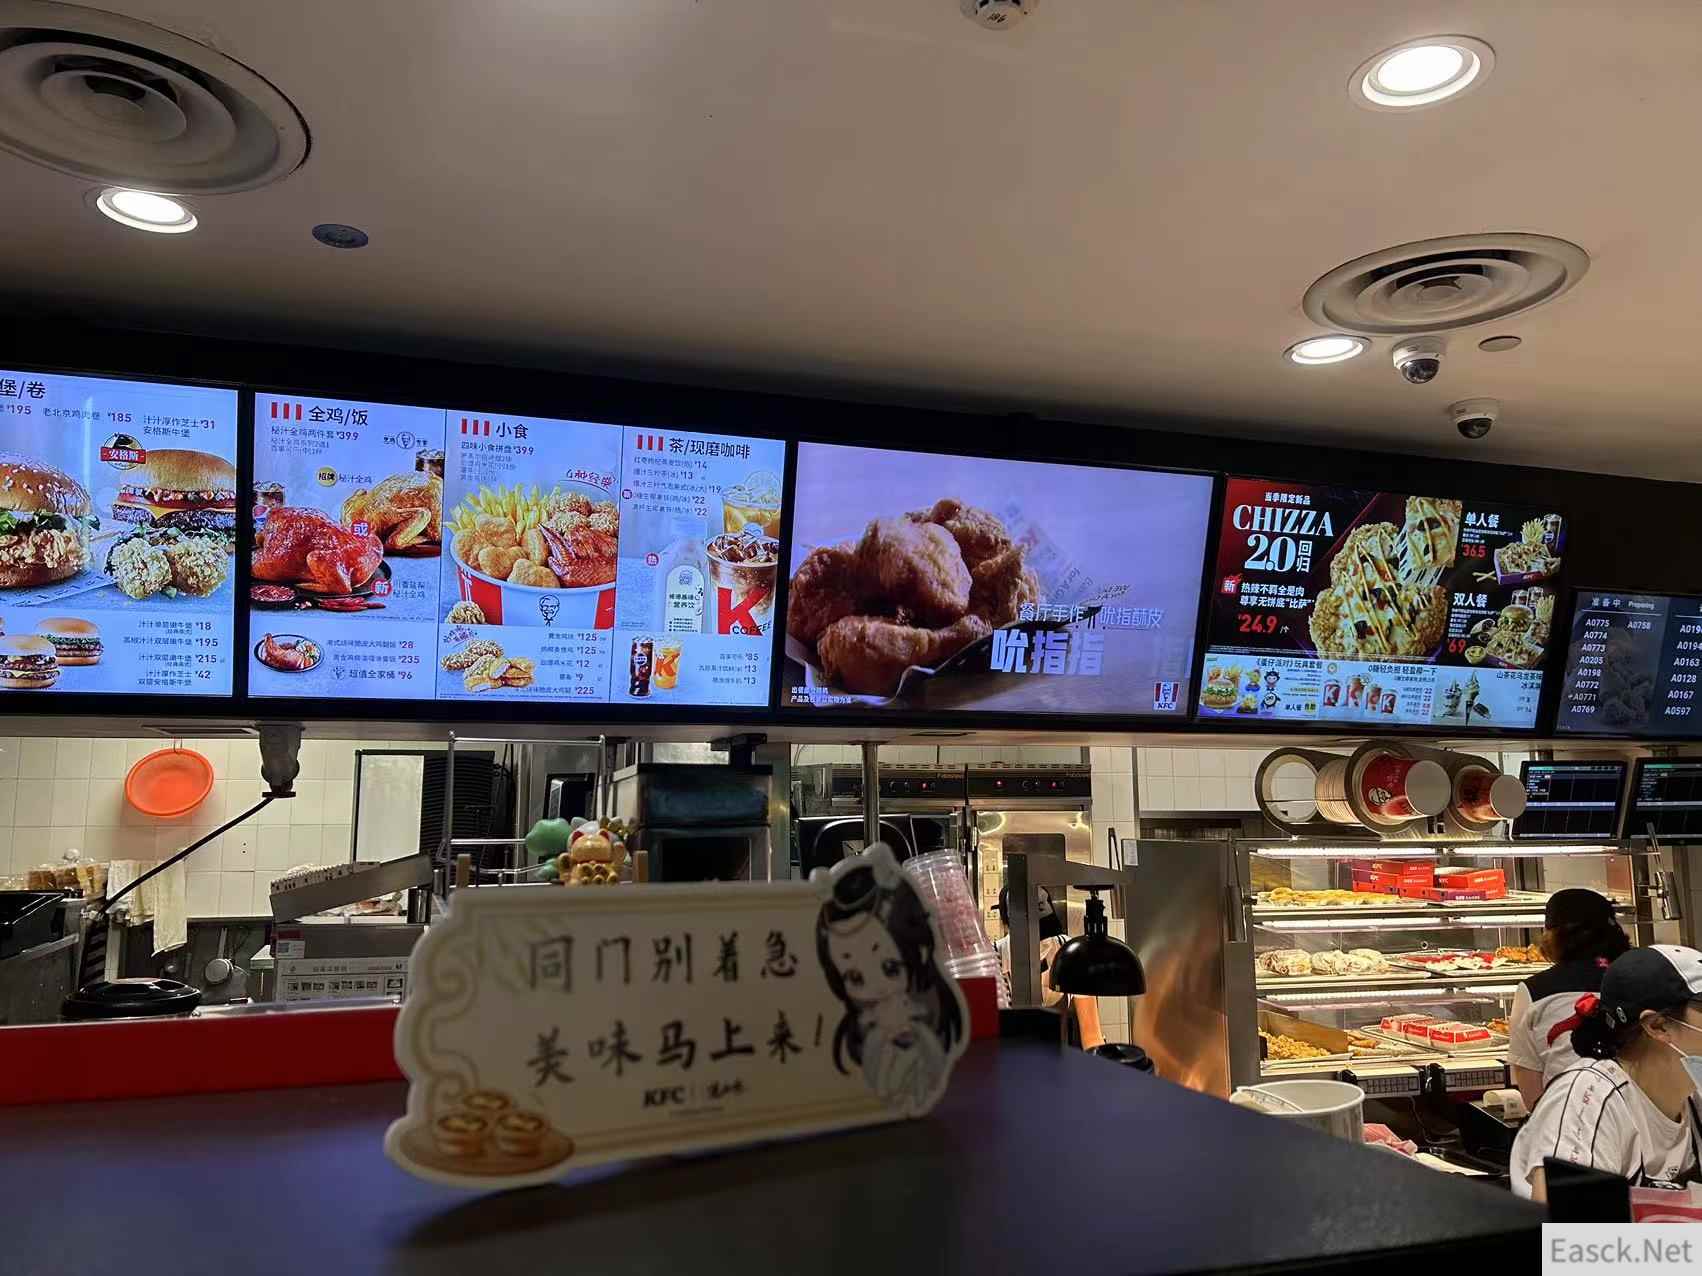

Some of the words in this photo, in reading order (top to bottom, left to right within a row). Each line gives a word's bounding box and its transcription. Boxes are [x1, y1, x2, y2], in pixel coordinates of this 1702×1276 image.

[308, 405, 368, 426] 全鸡/饭
[496, 422, 529, 439] 小食
[669, 437, 751, 460] 茶/现磨咖啡
[1232, 504, 1334, 537] CHIZZA
[1465, 512, 1499, 528] 单人餐
[1244, 533, 1297, 572] 2.0
[1452, 592, 1488, 607] 双人餐
[1019, 602, 1085, 623] 餐厅手作
[1585, 618, 1610, 627] A0775
[1679, 624, 1702, 634] A019
[1583, 631, 1608, 640] A0774
[1575, 680, 1599, 689] A0772
[1670, 673, 1697, 683] A0128
[1667, 690, 1694, 699] A0167
[528, 930, 798, 993] 同门别着急
[642, 1086, 686, 1108] KFC
